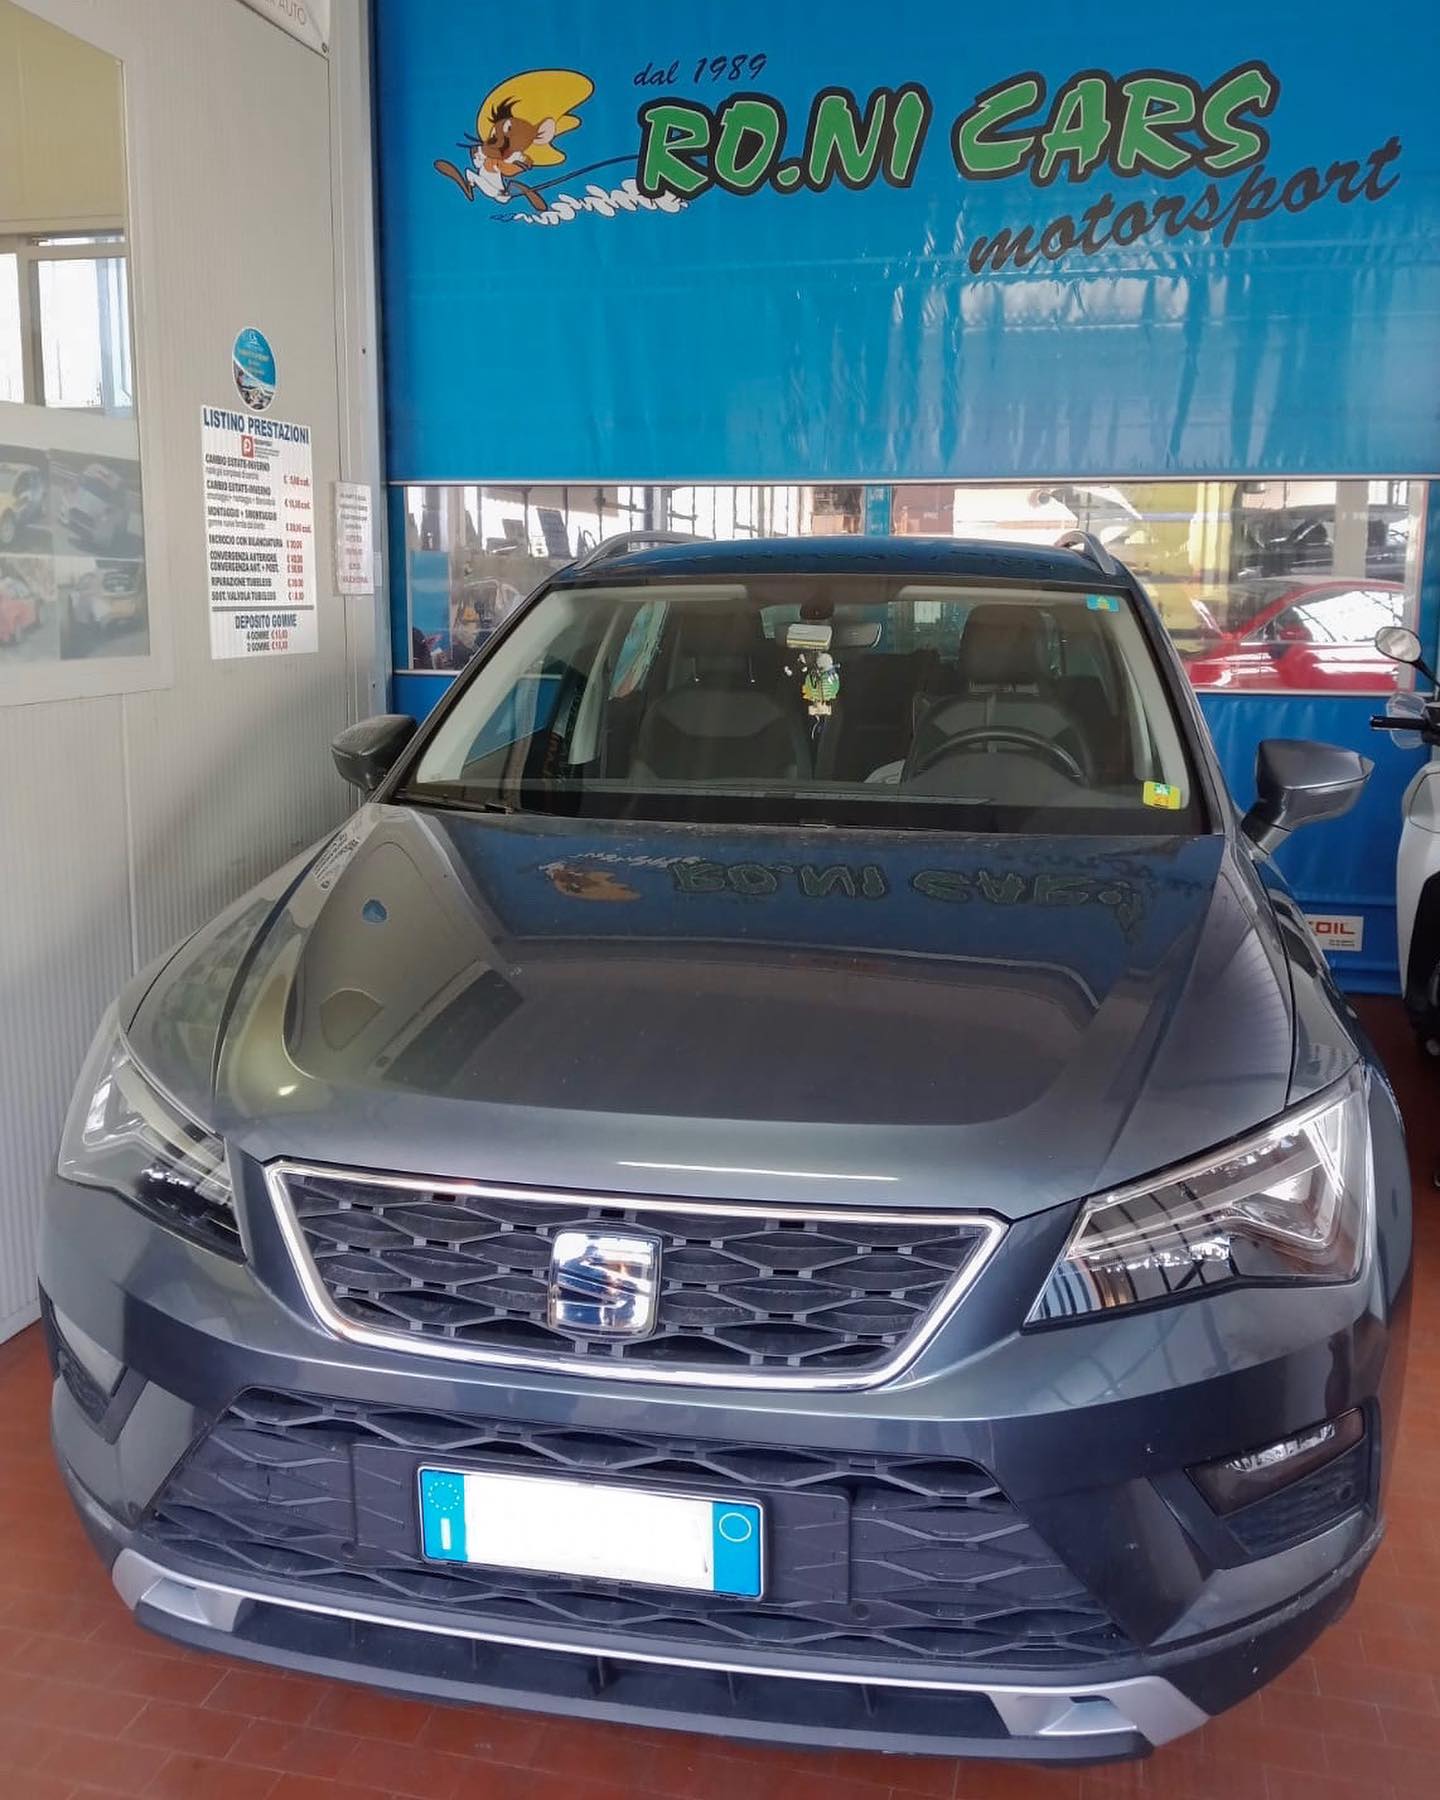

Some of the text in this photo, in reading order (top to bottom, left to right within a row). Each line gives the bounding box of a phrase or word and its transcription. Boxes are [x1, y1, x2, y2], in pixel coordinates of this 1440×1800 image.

[632, 53, 768, 89] dal 1989
[635, 60, 1282, 199] RO.NI CARS
[970, 136, 1402, 276] motorsport
[203, 408, 309, 444] LISTINO PRESTAZIONI
[210, 550, 249, 562] CONVERGENZA
[210, 561, 249, 572] CONVERGENZA
[235, 614, 297, 629] DEPOSITO GOMME
